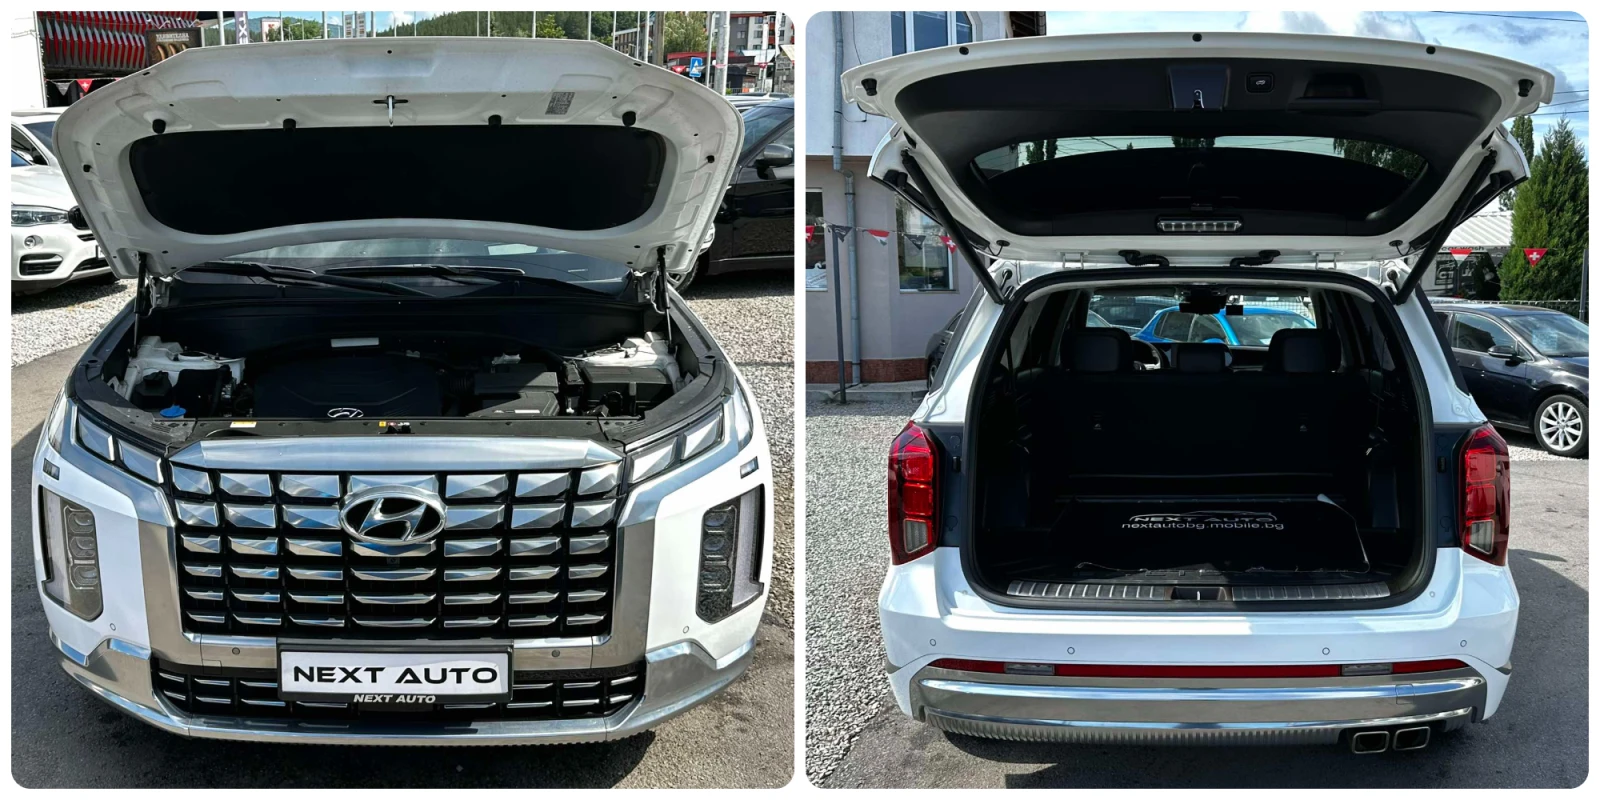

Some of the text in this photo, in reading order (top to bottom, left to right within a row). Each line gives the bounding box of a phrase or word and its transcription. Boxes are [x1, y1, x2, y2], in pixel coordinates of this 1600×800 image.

[1121, 522, 1284, 530] nextautobg.mobile.bg
[293, 665, 498, 684] NEXT AUTO
[353, 694, 436, 704] NEXT AUTO
